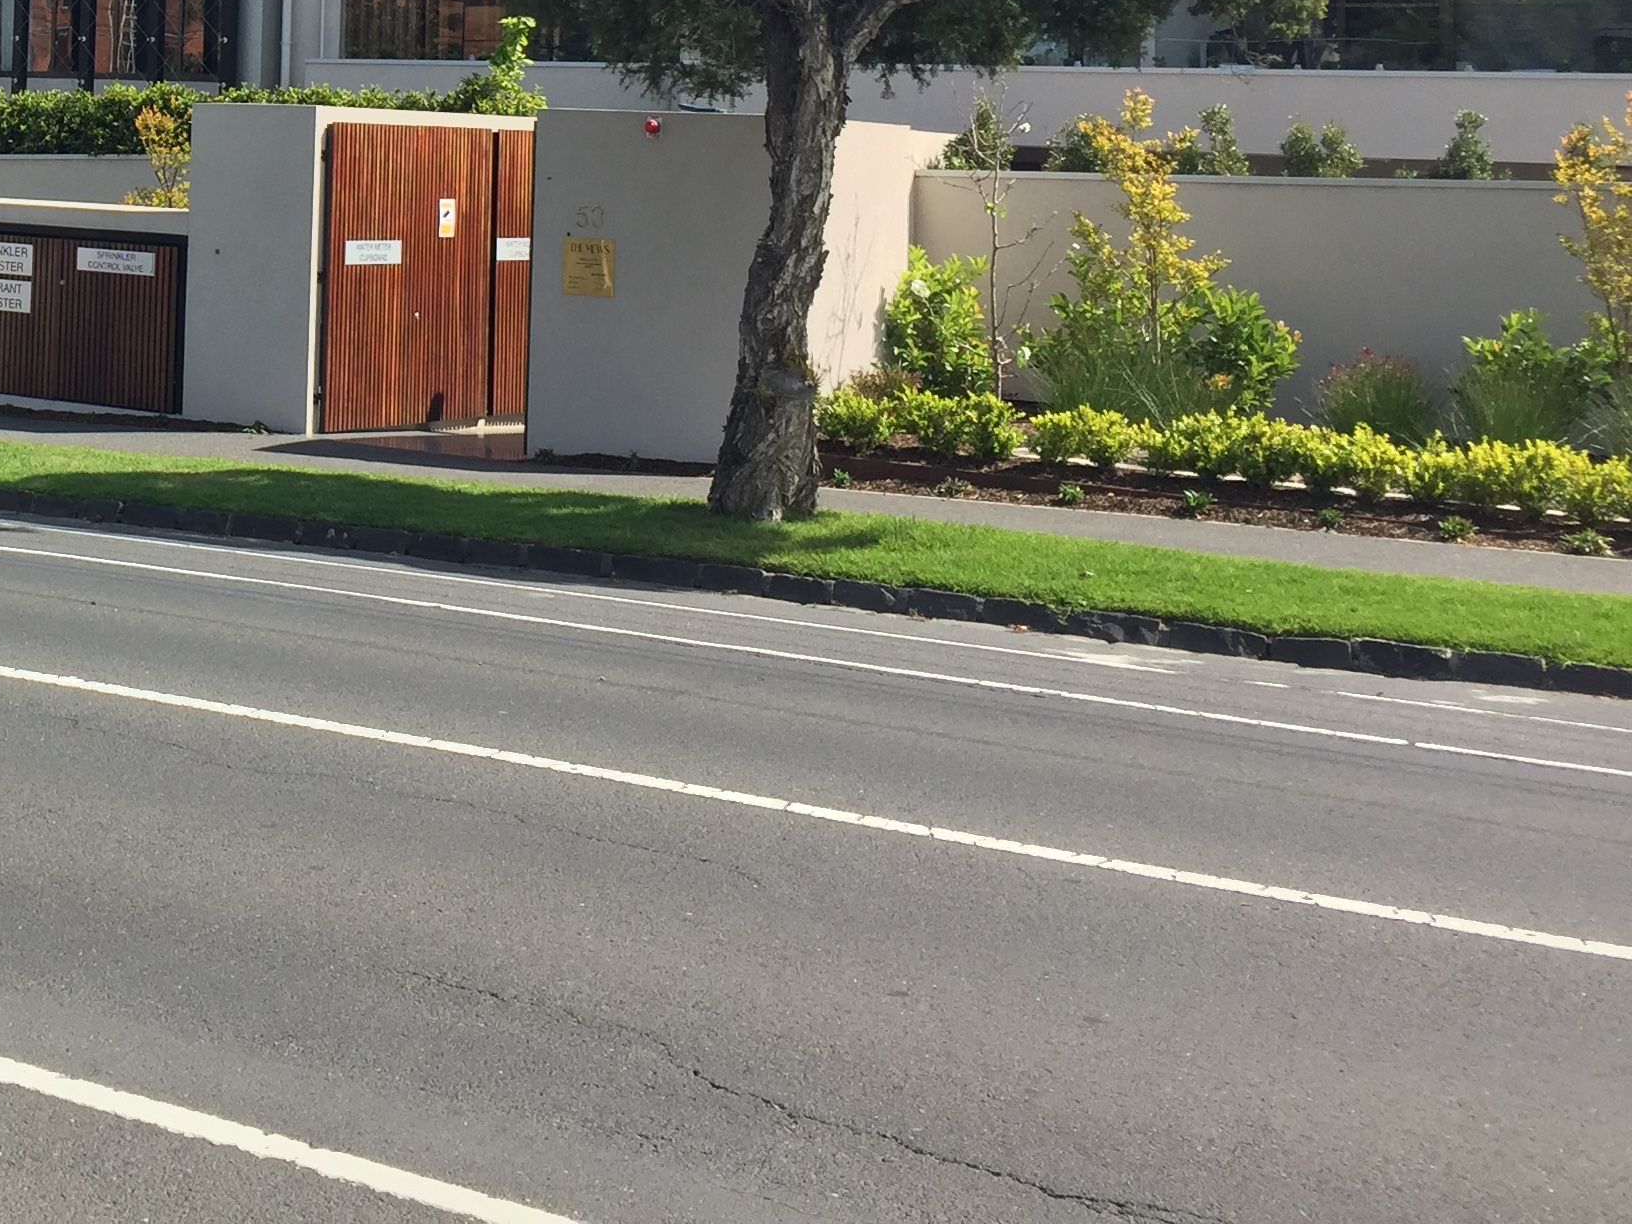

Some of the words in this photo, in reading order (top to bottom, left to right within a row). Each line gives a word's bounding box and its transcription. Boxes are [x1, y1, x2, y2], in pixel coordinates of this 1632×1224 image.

[96, 250, 136, 261] SPRINKLER
[87, 260, 121, 272] CONTROL
[122, 263, 144, 273] VALVE
